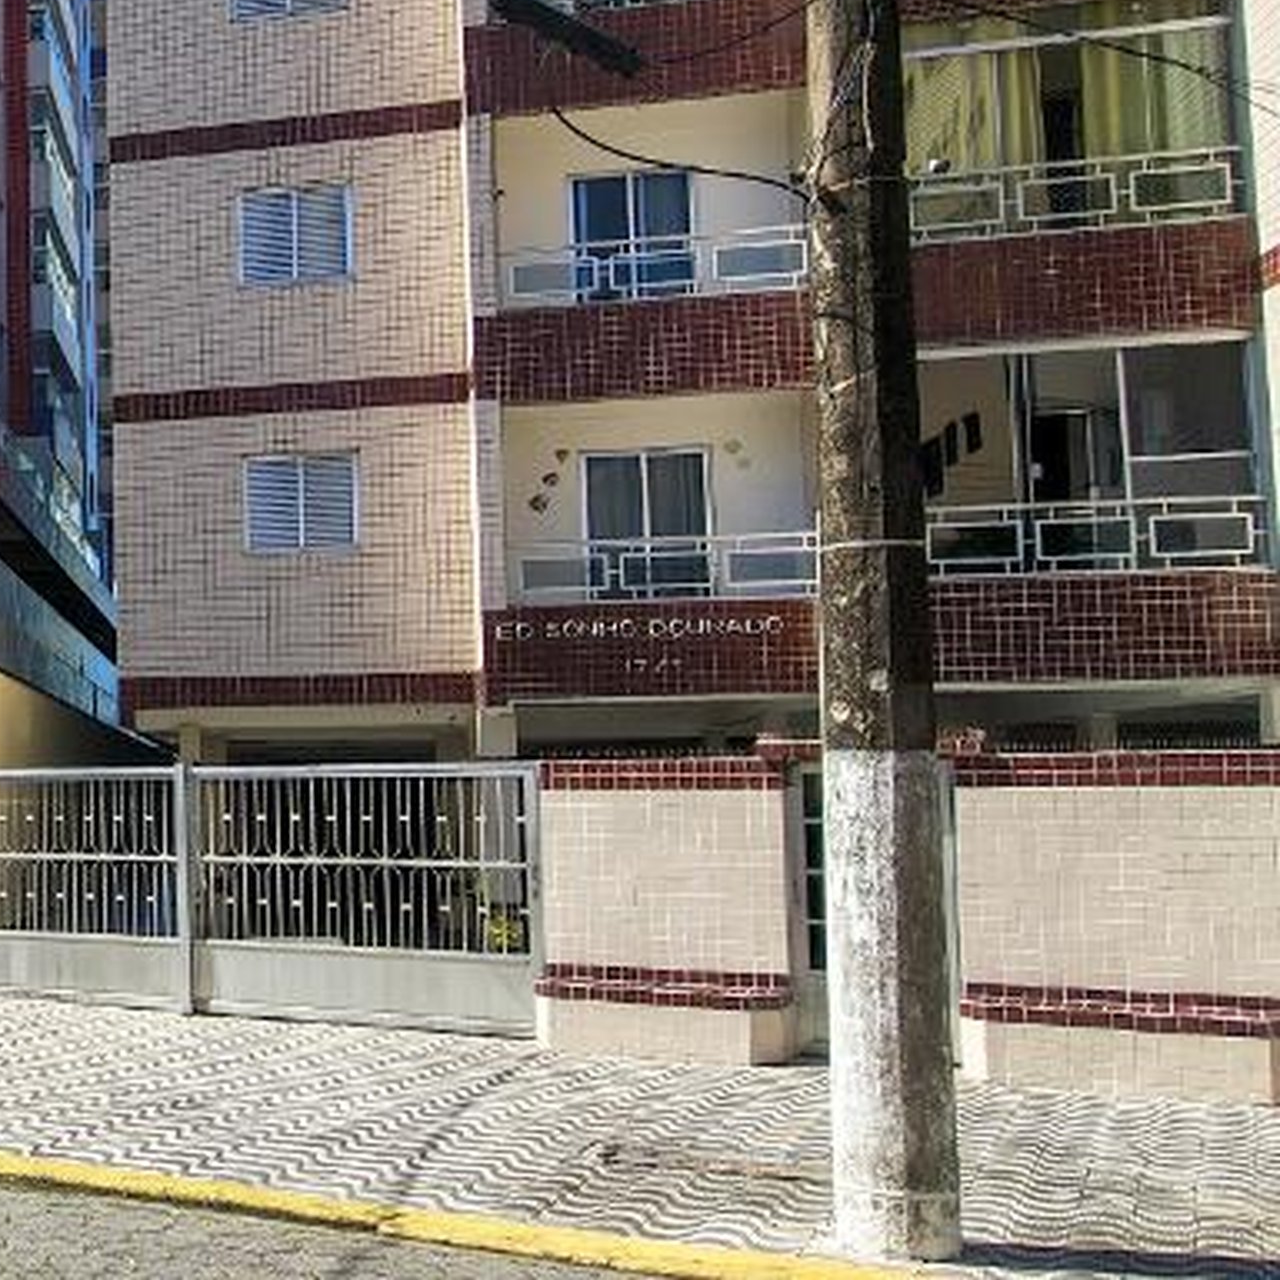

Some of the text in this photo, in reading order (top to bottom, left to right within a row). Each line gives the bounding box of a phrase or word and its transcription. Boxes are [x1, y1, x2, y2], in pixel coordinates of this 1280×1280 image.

[495, 615, 784, 640] ED SONHO DOURADO
